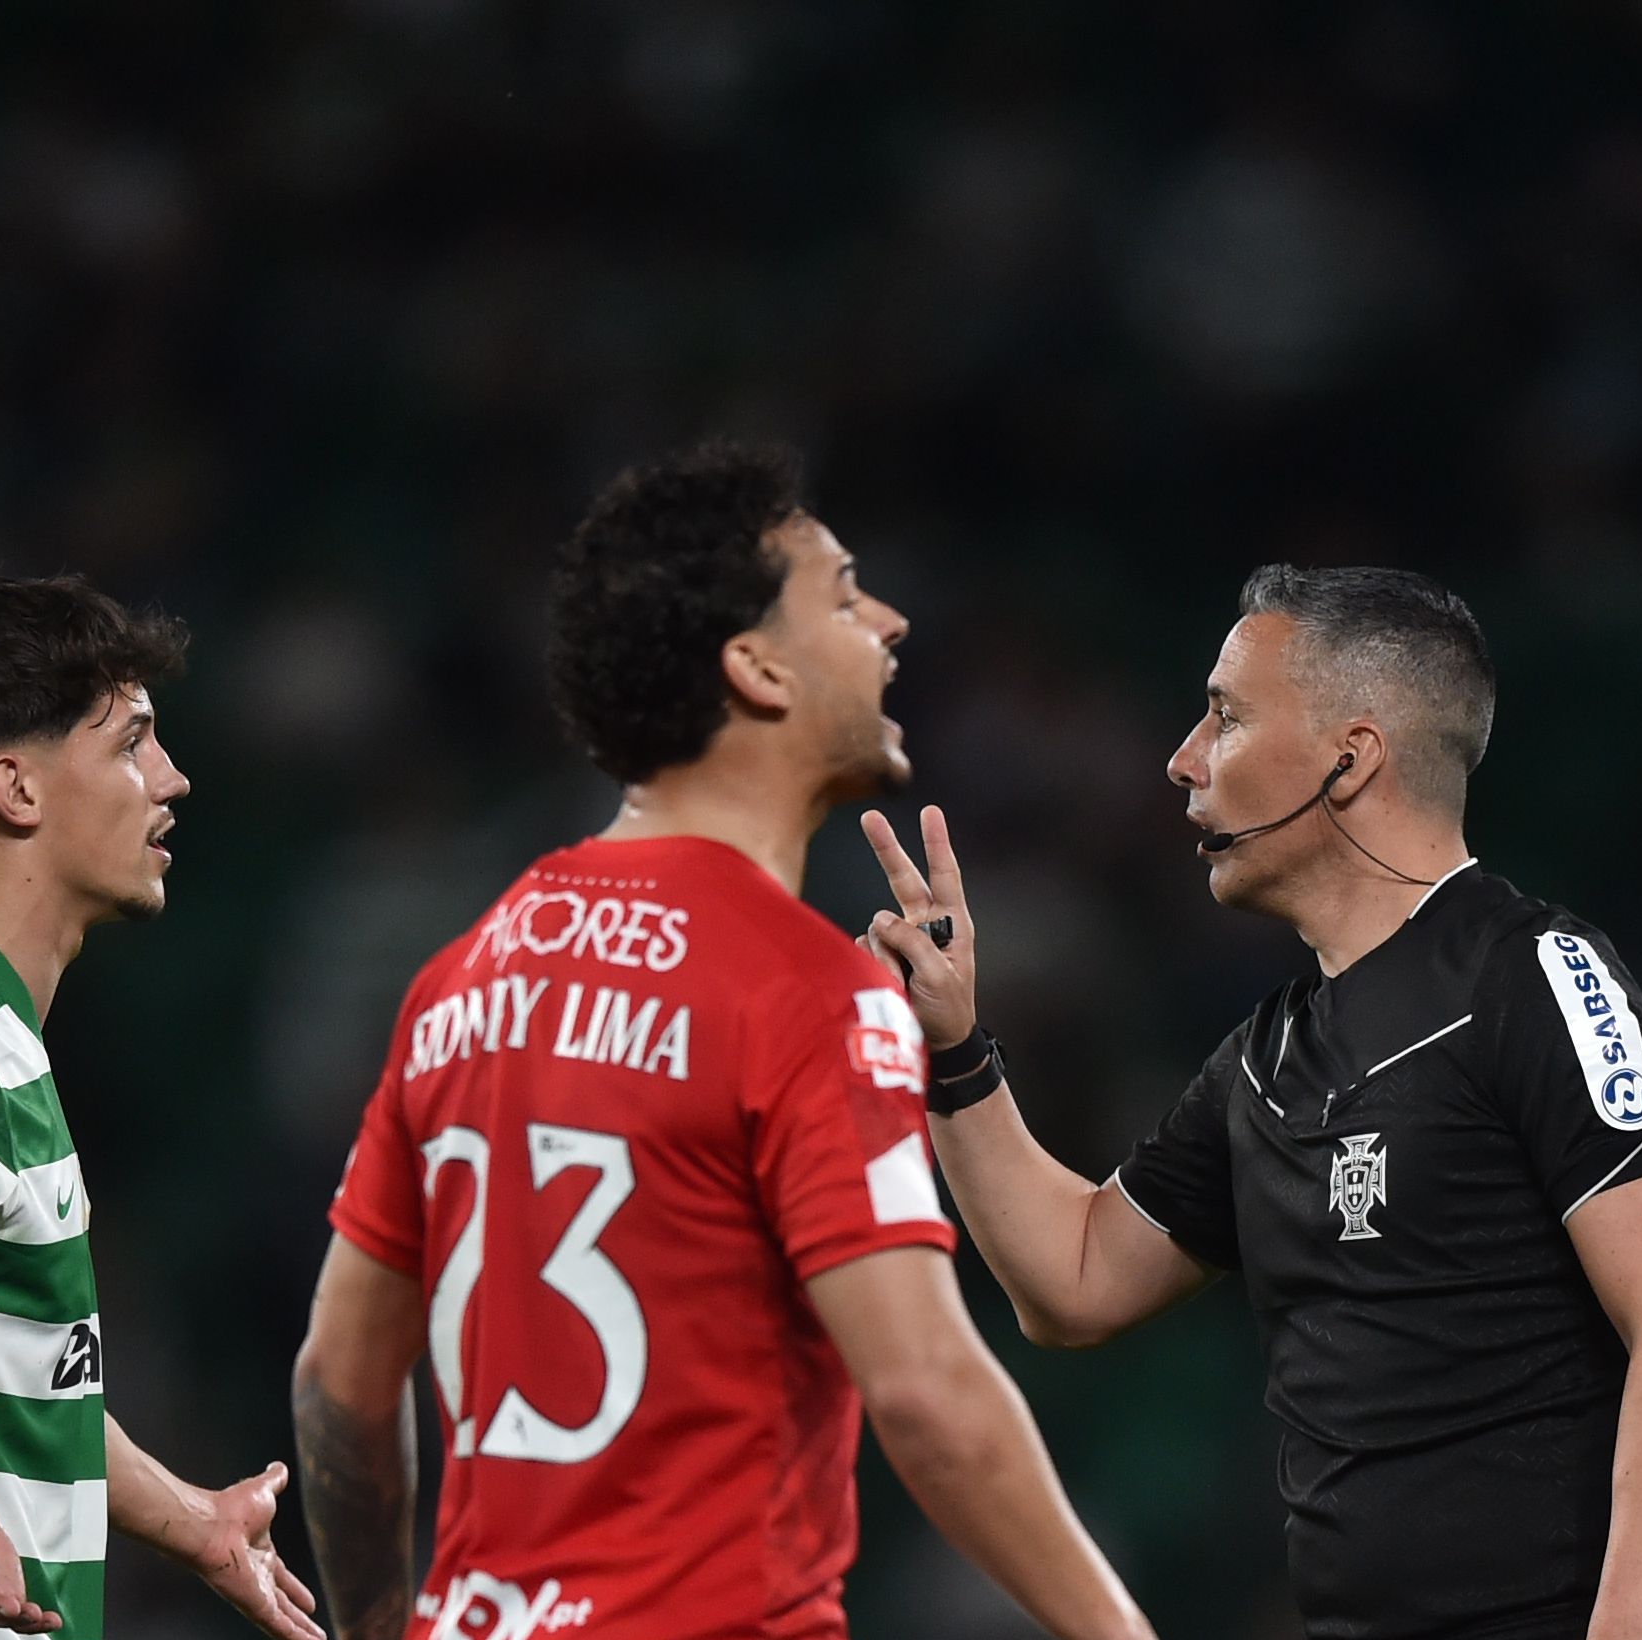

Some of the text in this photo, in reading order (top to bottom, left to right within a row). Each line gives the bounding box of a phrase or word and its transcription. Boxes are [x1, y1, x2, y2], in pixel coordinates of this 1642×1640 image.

[553, 981, 692, 1081] LIMA
[1553, 935, 1628, 1066] SABSEG
[420, 1122, 649, 1464] 23
